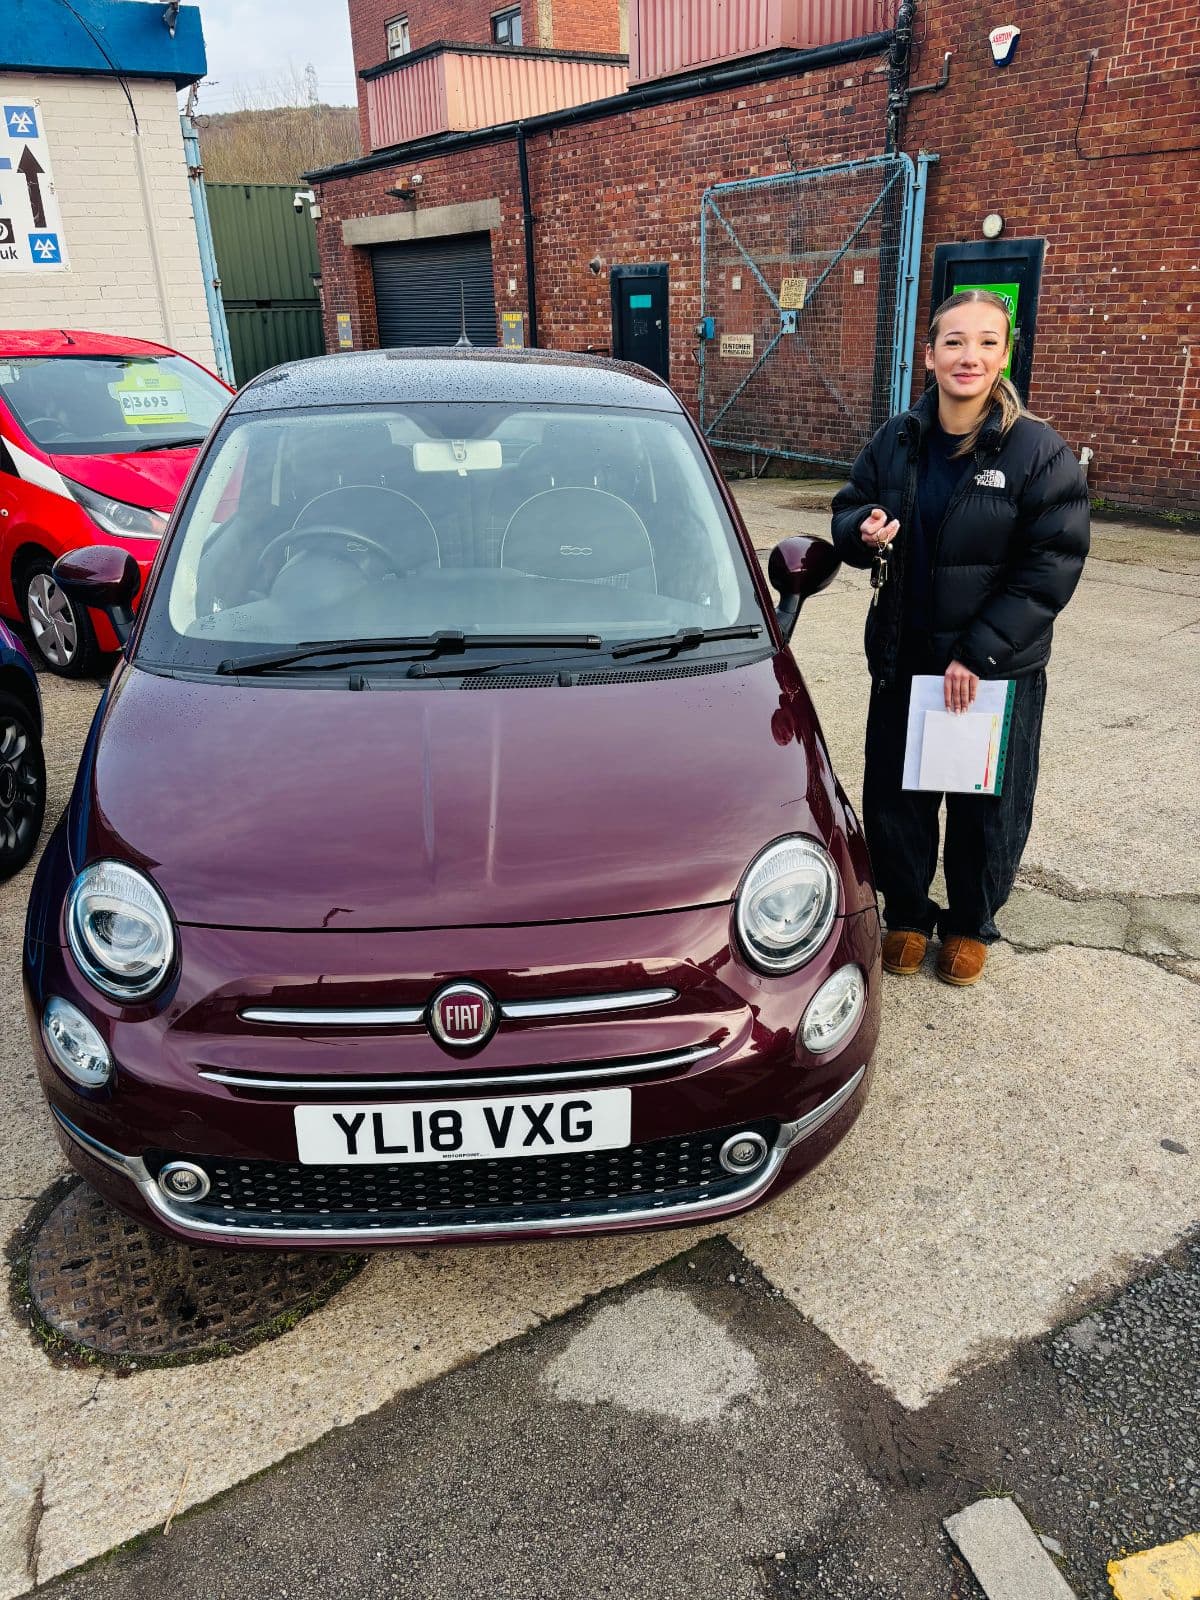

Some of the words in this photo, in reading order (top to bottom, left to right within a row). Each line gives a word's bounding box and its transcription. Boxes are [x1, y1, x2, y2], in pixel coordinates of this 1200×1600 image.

[446, 1004, 481, 1031] FIAT
[332, 1109, 463, 1155] YL18
[482, 1099, 593, 1149] VXG
